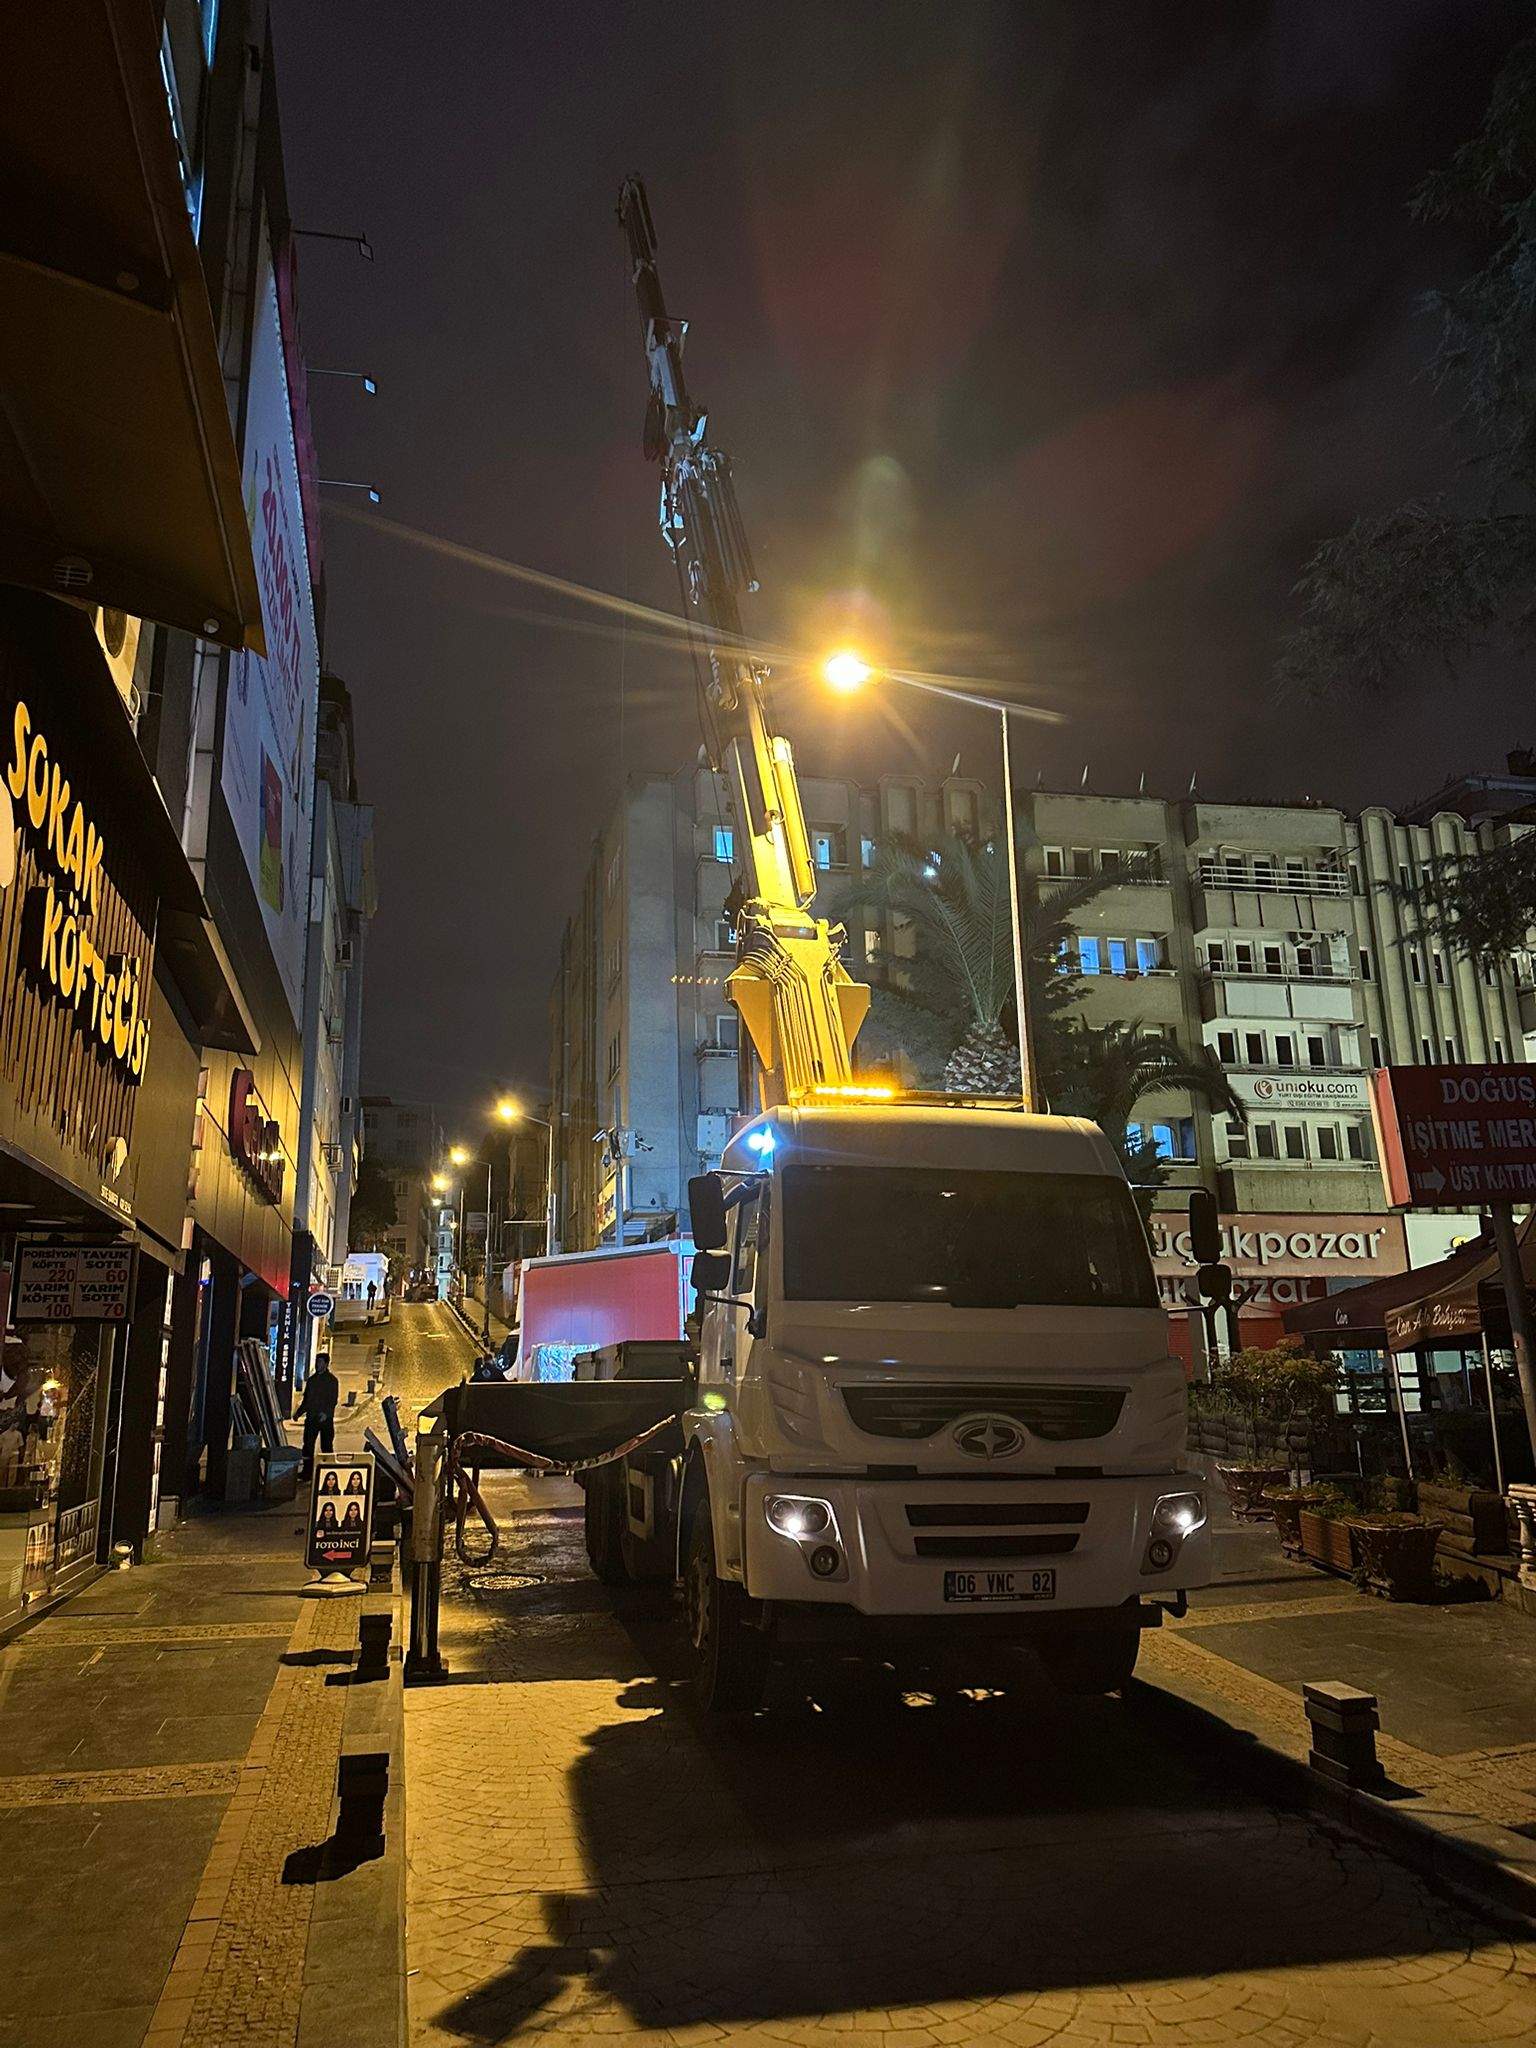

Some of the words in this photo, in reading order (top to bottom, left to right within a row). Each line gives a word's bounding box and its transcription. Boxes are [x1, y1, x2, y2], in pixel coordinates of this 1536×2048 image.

[8, 700, 104, 917] SOKAK
[41, 886, 151, 1087] KÖFTECİSİ
[1276, 1080, 1358, 1094] unioku.com
[1440, 1070, 1536, 1109] DOĞUŞ
[1406, 1113, 1484, 1158] İŞİTME
[1487, 1118, 1536, 1148] MER
[1449, 1160, 1480, 1191] ÜST
[1484, 1163, 1536, 1190] KATTA
[1152, 1223, 1382, 1267] üçükpazar
[24, 1249, 77, 1259] PORSİYON
[82, 1251, 128, 1259] TAVUK
[32, 1260, 66, 1269] KÖFTE
[86, 1260, 122, 1269] SOTE
[48, 1269, 75, 1283] 220
[106, 1269, 128, 1283] 60
[24, 1283, 69, 1292] YARIM
[80, 1284, 124, 1293] YARIM
[22, 1294, 69, 1303] KÖFTE
[81, 1294, 120, 1302] SOTE
[46, 1303, 72, 1317] 100
[103, 1303, 124, 1317] 70
[957, 1574, 976, 1594] 06
[987, 1573, 1015, 1593] VNC
[1032, 1572, 1051, 1592] 82
